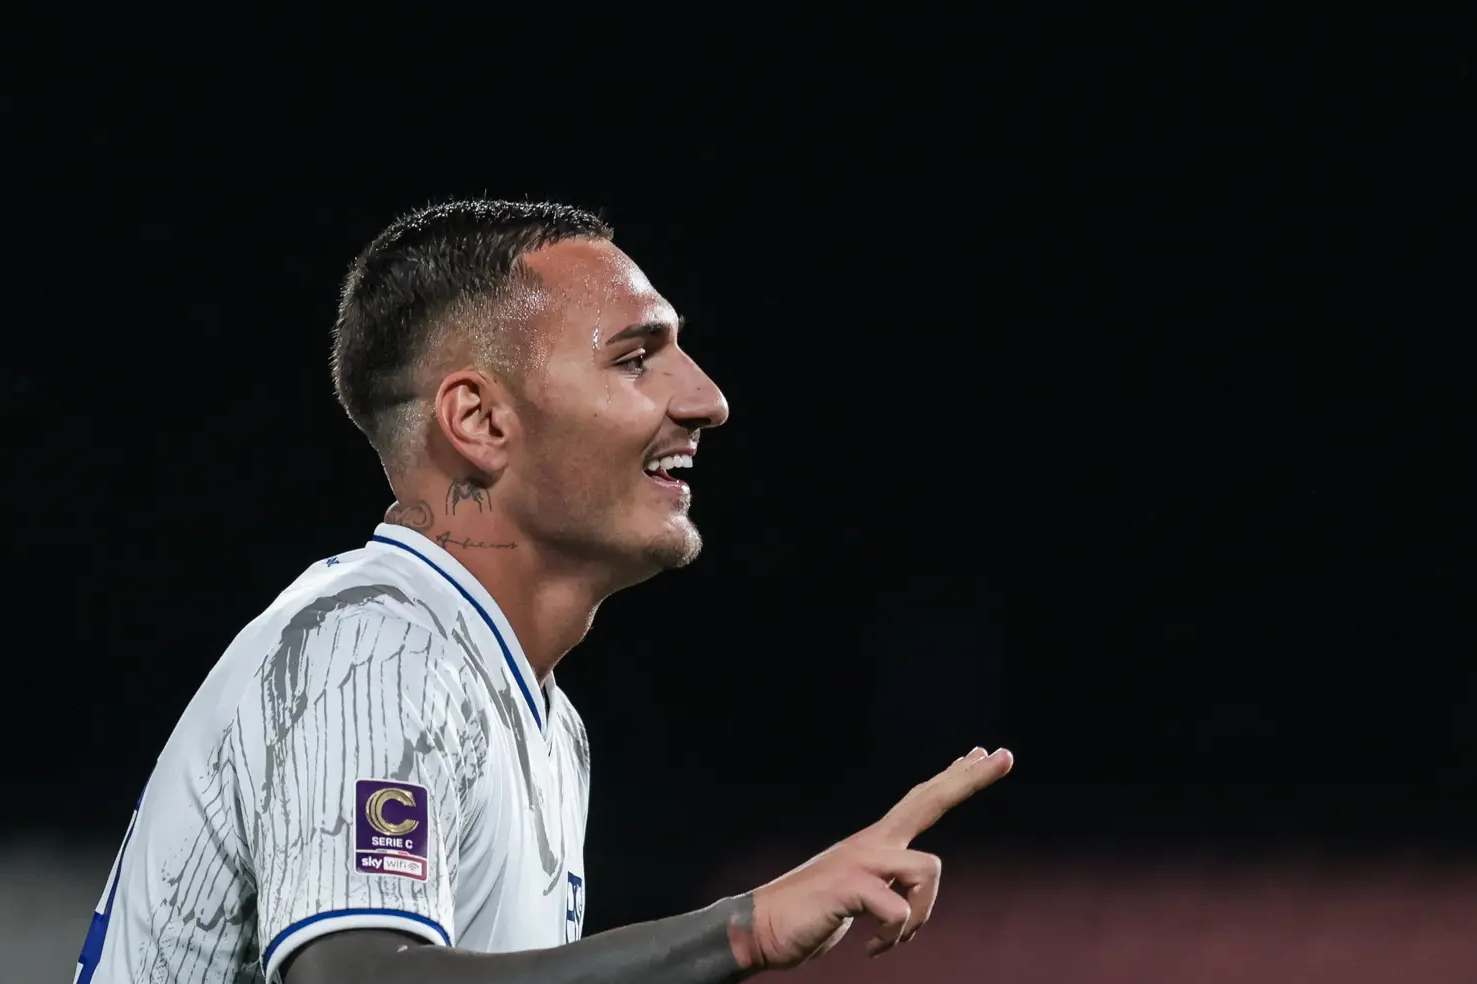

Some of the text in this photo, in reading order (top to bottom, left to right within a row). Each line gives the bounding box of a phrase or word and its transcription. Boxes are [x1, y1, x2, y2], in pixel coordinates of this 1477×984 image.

[371, 836, 413, 849] SERIE C
[361, 856, 407, 869] sky wifi
